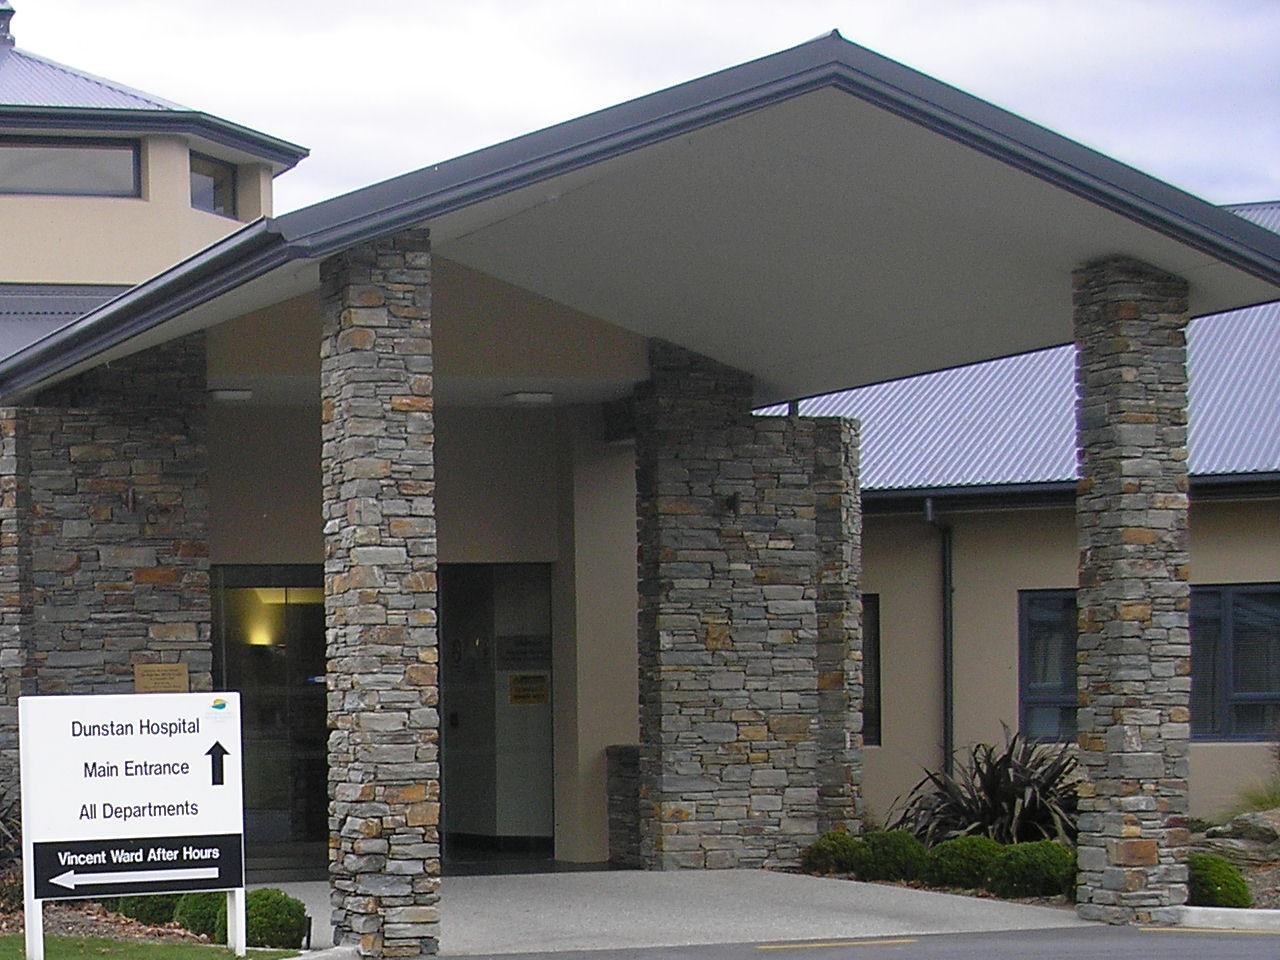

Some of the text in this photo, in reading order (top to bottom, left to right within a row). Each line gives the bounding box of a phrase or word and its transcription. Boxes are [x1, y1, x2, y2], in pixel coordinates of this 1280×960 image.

[71, 718, 200, 738] Dunstan Hospital
[83, 760, 189, 778] Main Entrance
[79, 801, 199, 821] All Departments
[58, 846, 220, 866] Vincent Ward After Hours
